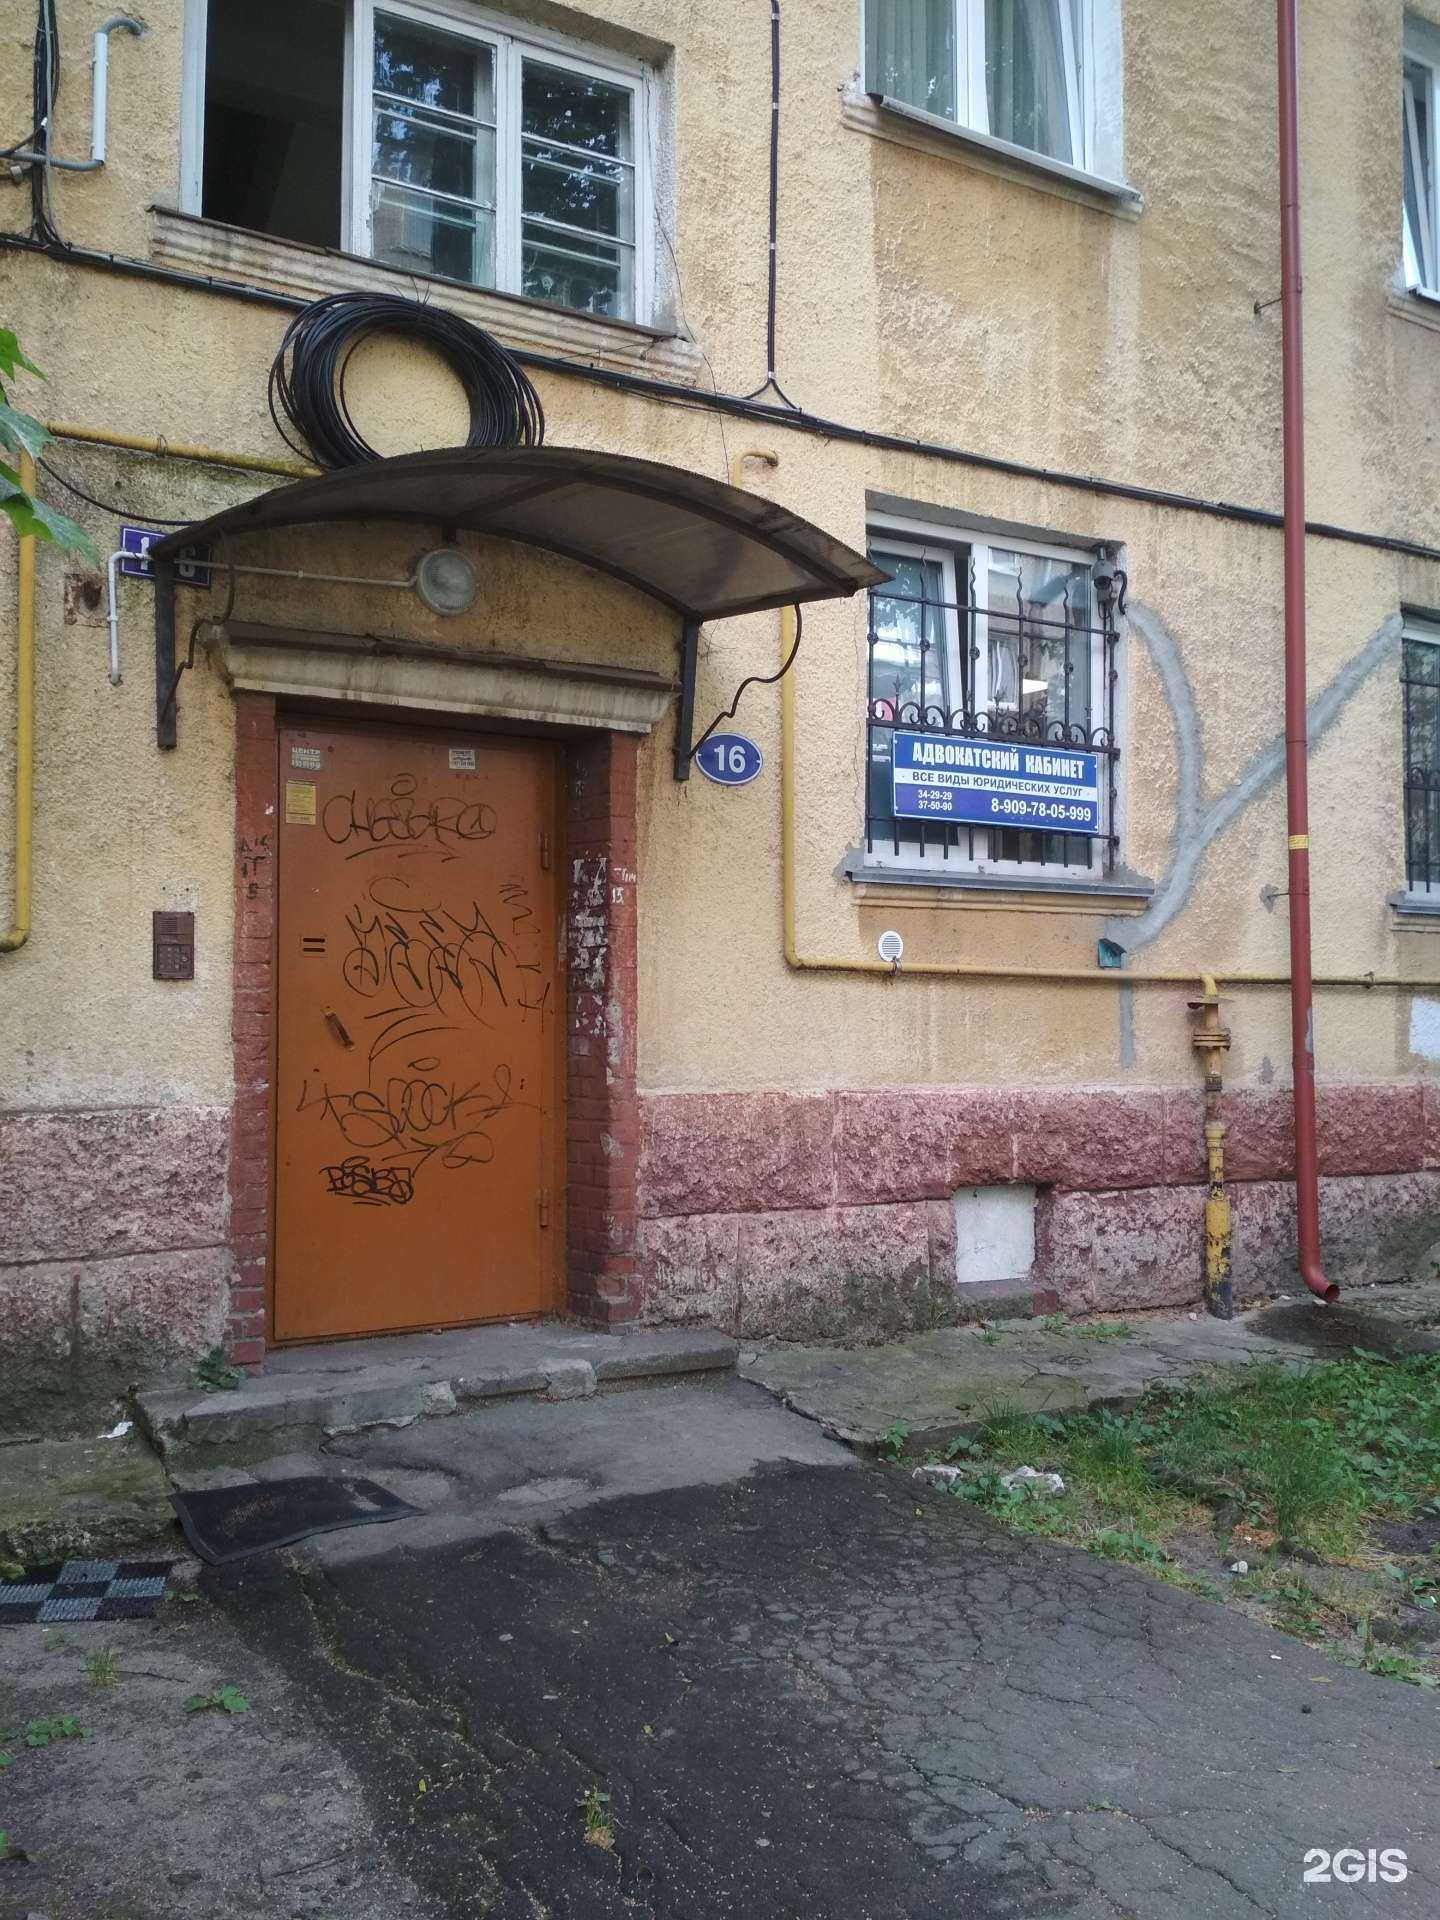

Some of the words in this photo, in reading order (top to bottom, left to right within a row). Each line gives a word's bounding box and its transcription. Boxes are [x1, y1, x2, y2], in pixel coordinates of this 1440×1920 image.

[714, 744, 746, 773] 16
[912, 742, 1019, 772] АДВОКАТСКИЙ
[1025, 755, 1085, 779] КАБИНЕТ
[912, 771, 934, 783] ВСЕ
[938, 774, 970, 786] ВИДЫ
[973, 776, 1051, 794] ЮРИДИЧЕСКИХ
[1053, 786, 1083, 797] УСЛУГ
[918, 789, 952, 800] 34-29-29
[918, 800, 952, 811] 37-50-90
[991, 798, 1091, 821] 8-909-78-05-999
